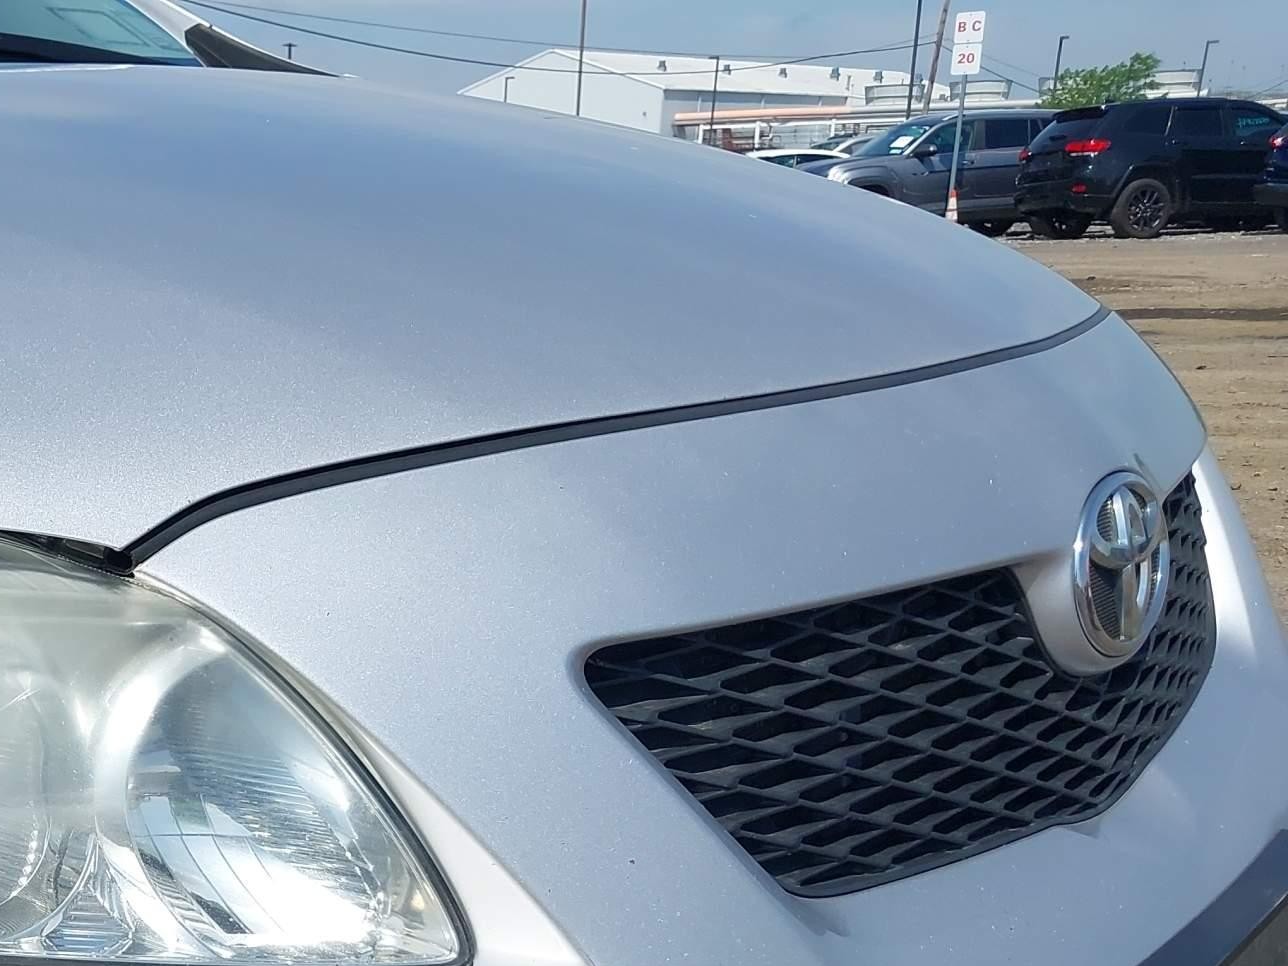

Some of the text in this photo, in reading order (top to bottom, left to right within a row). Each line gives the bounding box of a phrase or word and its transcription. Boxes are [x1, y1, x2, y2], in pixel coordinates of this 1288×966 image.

[957, 20, 982, 33] B C
[957, 52, 975, 64] 20
